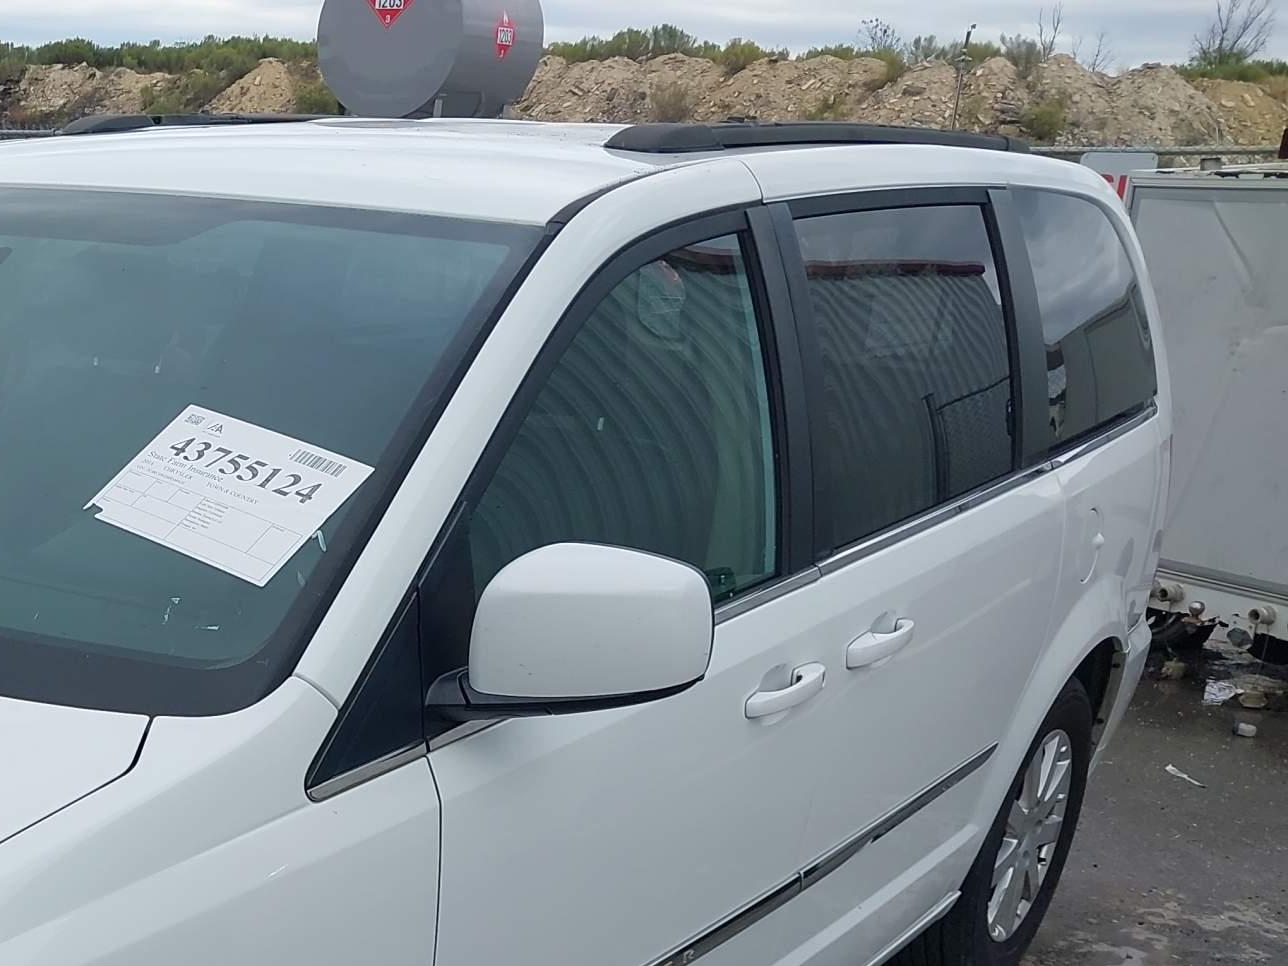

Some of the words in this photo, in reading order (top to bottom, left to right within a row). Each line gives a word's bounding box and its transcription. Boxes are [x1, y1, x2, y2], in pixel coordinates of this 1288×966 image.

[378, 0, 403, 8] 1203
[166, 458, 188, 469] Farm
[186, 464, 225, 483] Insurance
[169, 437, 322, 504] 43755124
